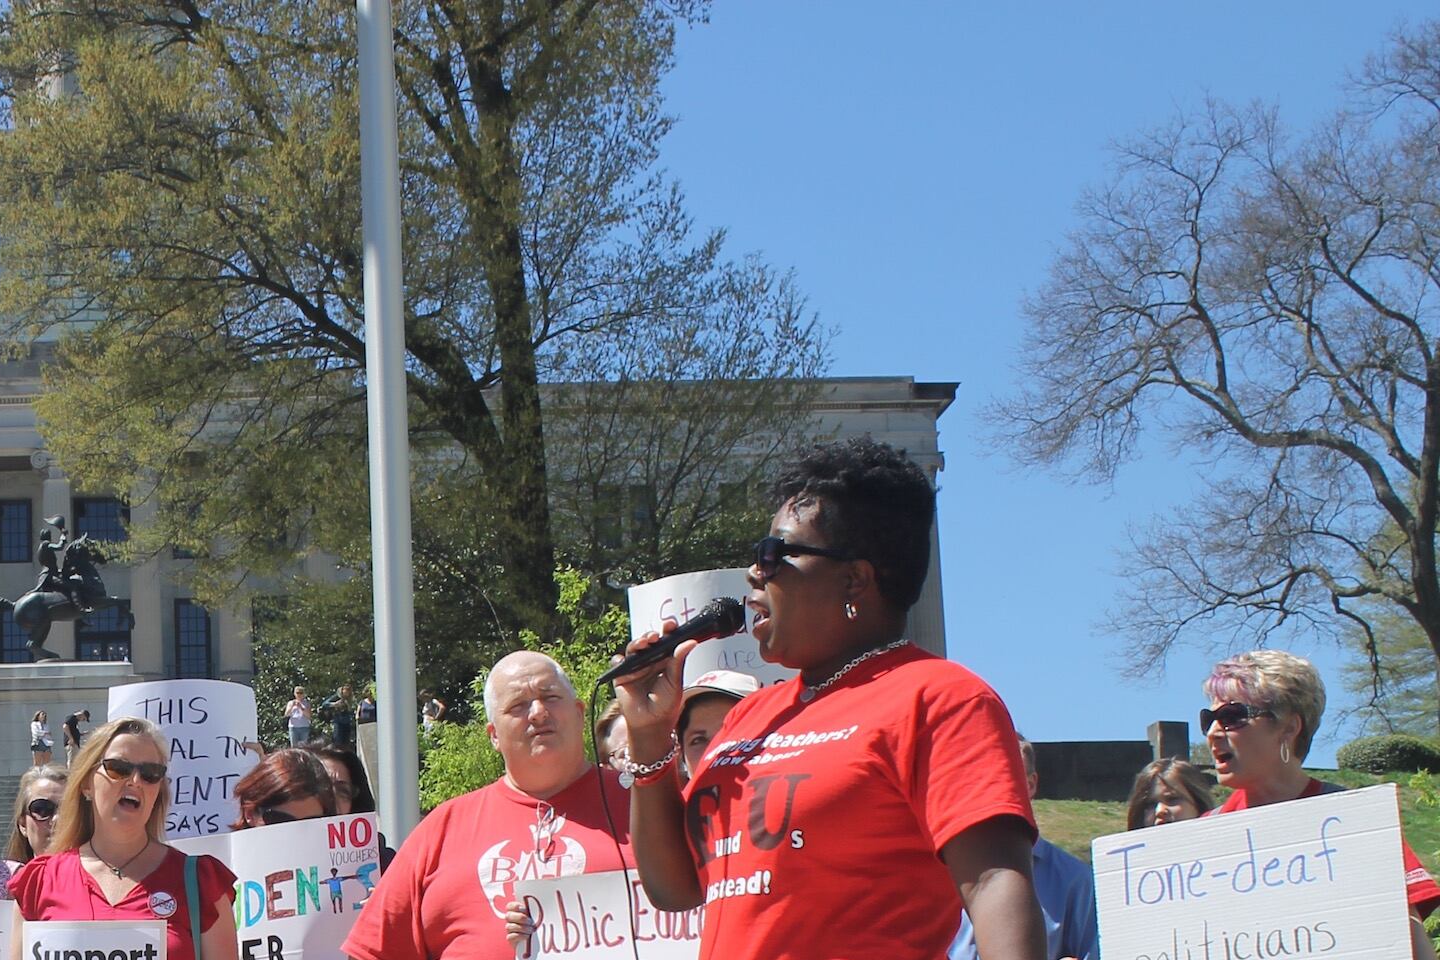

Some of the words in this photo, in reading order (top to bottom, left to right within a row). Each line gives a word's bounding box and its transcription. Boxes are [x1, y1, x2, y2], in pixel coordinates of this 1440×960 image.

[137, 696, 208, 724] THIS
[170, 774, 241, 806] ENT
[328, 817, 372, 849] NO
[329, 848, 379, 867] VOUCHERS
[1106, 816, 1342, 906] Tone-deaf
[522, 889, 625, 959] Public
